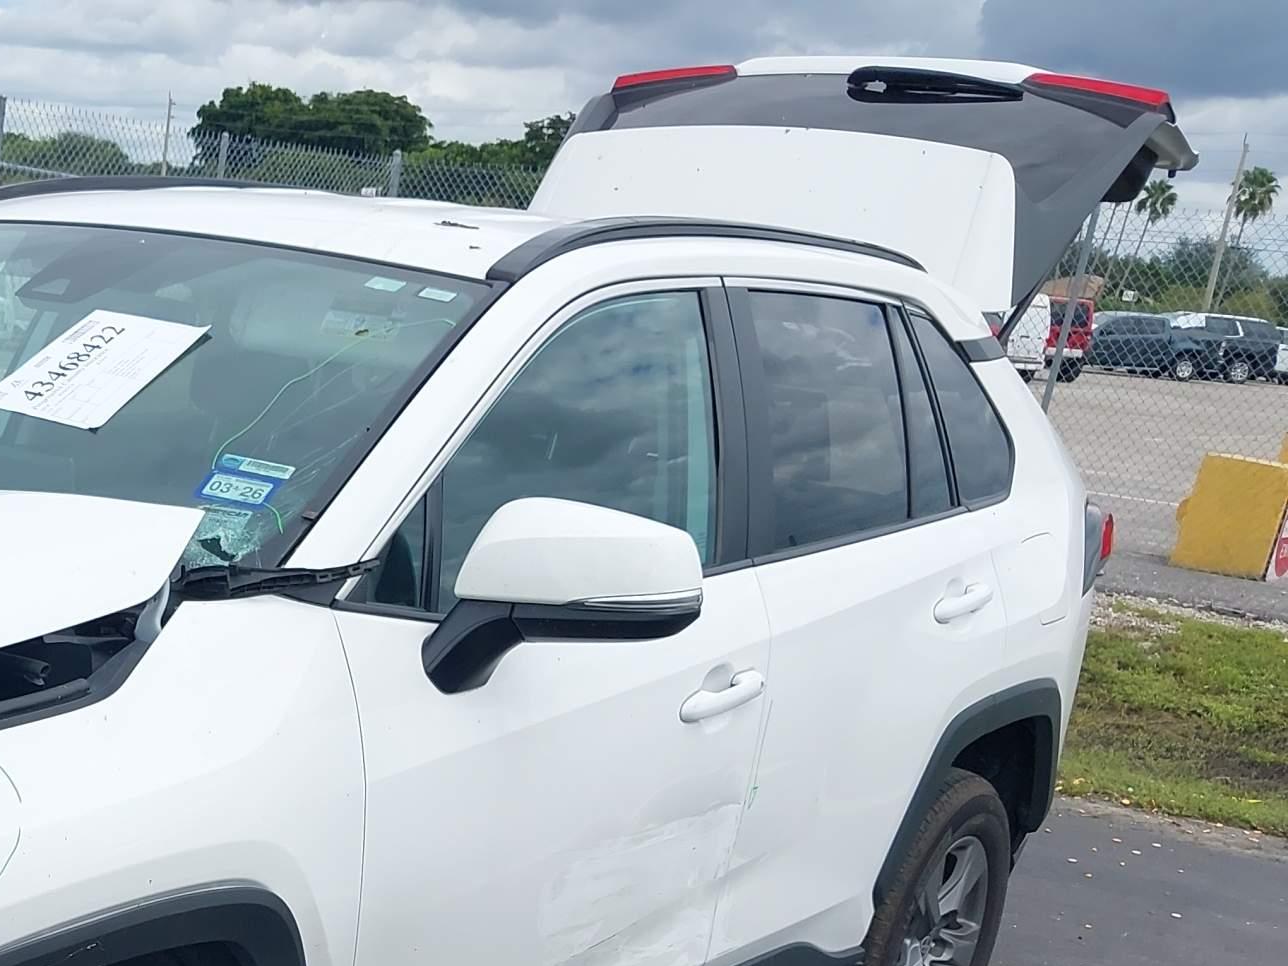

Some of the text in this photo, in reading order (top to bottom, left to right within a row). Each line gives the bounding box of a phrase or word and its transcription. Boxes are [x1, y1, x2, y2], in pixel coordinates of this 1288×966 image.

[23, 325, 126, 403] 43468422
[208, 480, 231, 494] 03
[239, 486, 265, 500] 26
